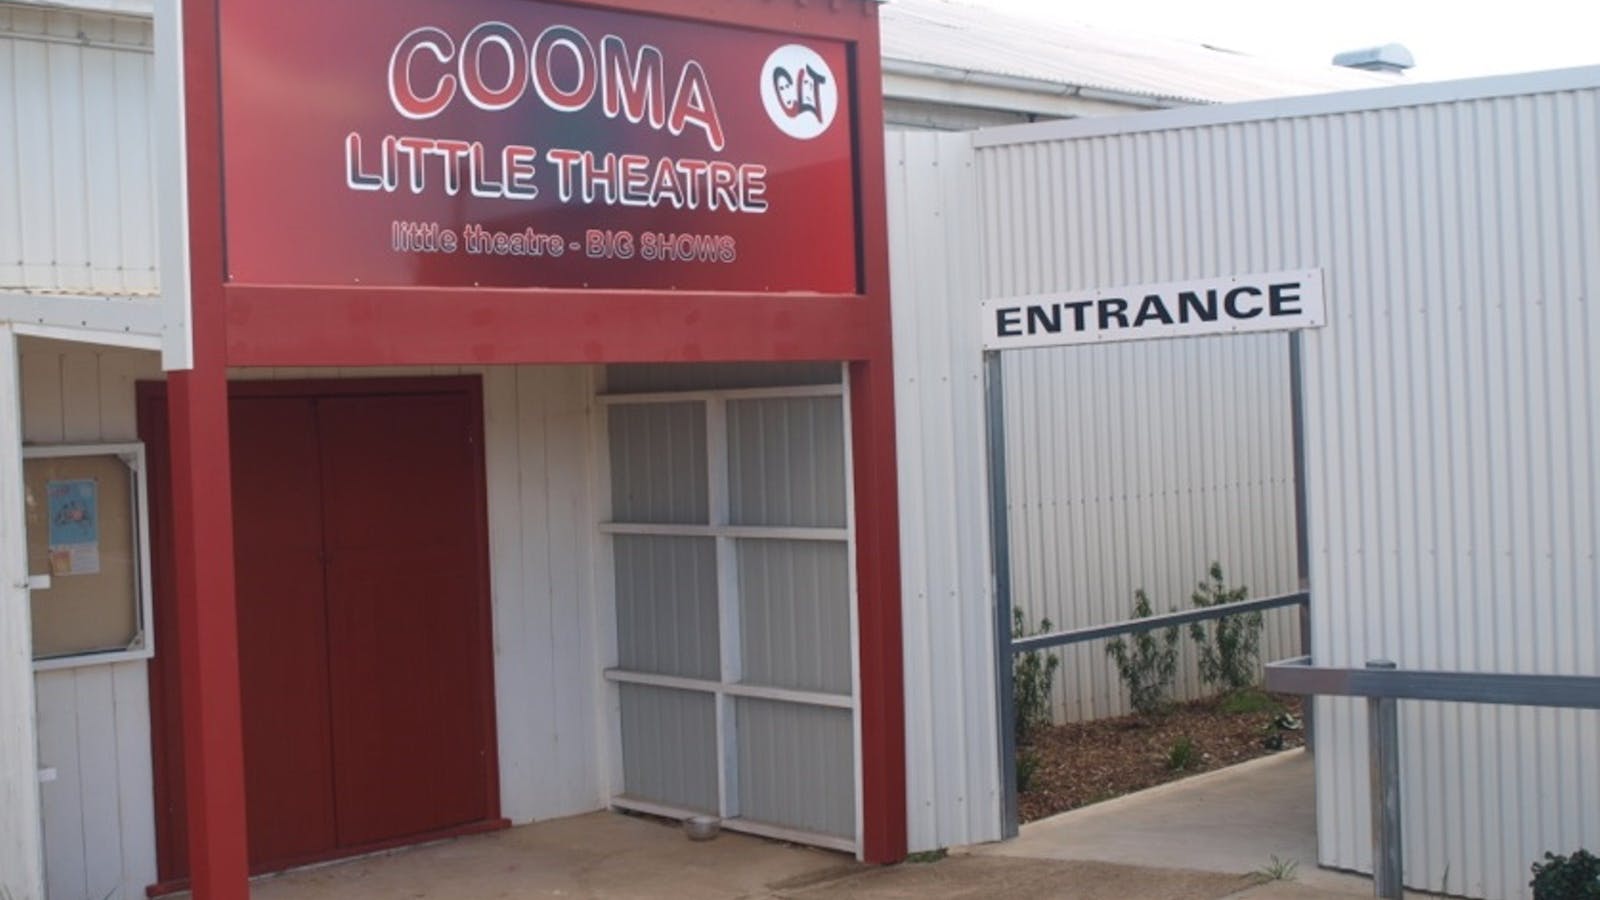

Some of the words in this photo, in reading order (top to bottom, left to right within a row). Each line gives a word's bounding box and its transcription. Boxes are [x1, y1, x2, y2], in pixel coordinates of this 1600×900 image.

[388, 21, 725, 152] COOMA
[345, 132, 539, 200] LITTLE
[547, 149, 769, 213] THEATRE
[392, 221, 457, 254] little
[464, 224, 565, 257] theatre
[585, 229, 636, 259] BIG
[640, 231, 736, 263] SHOWS
[995, 282, 1303, 338] ENTRANCE
